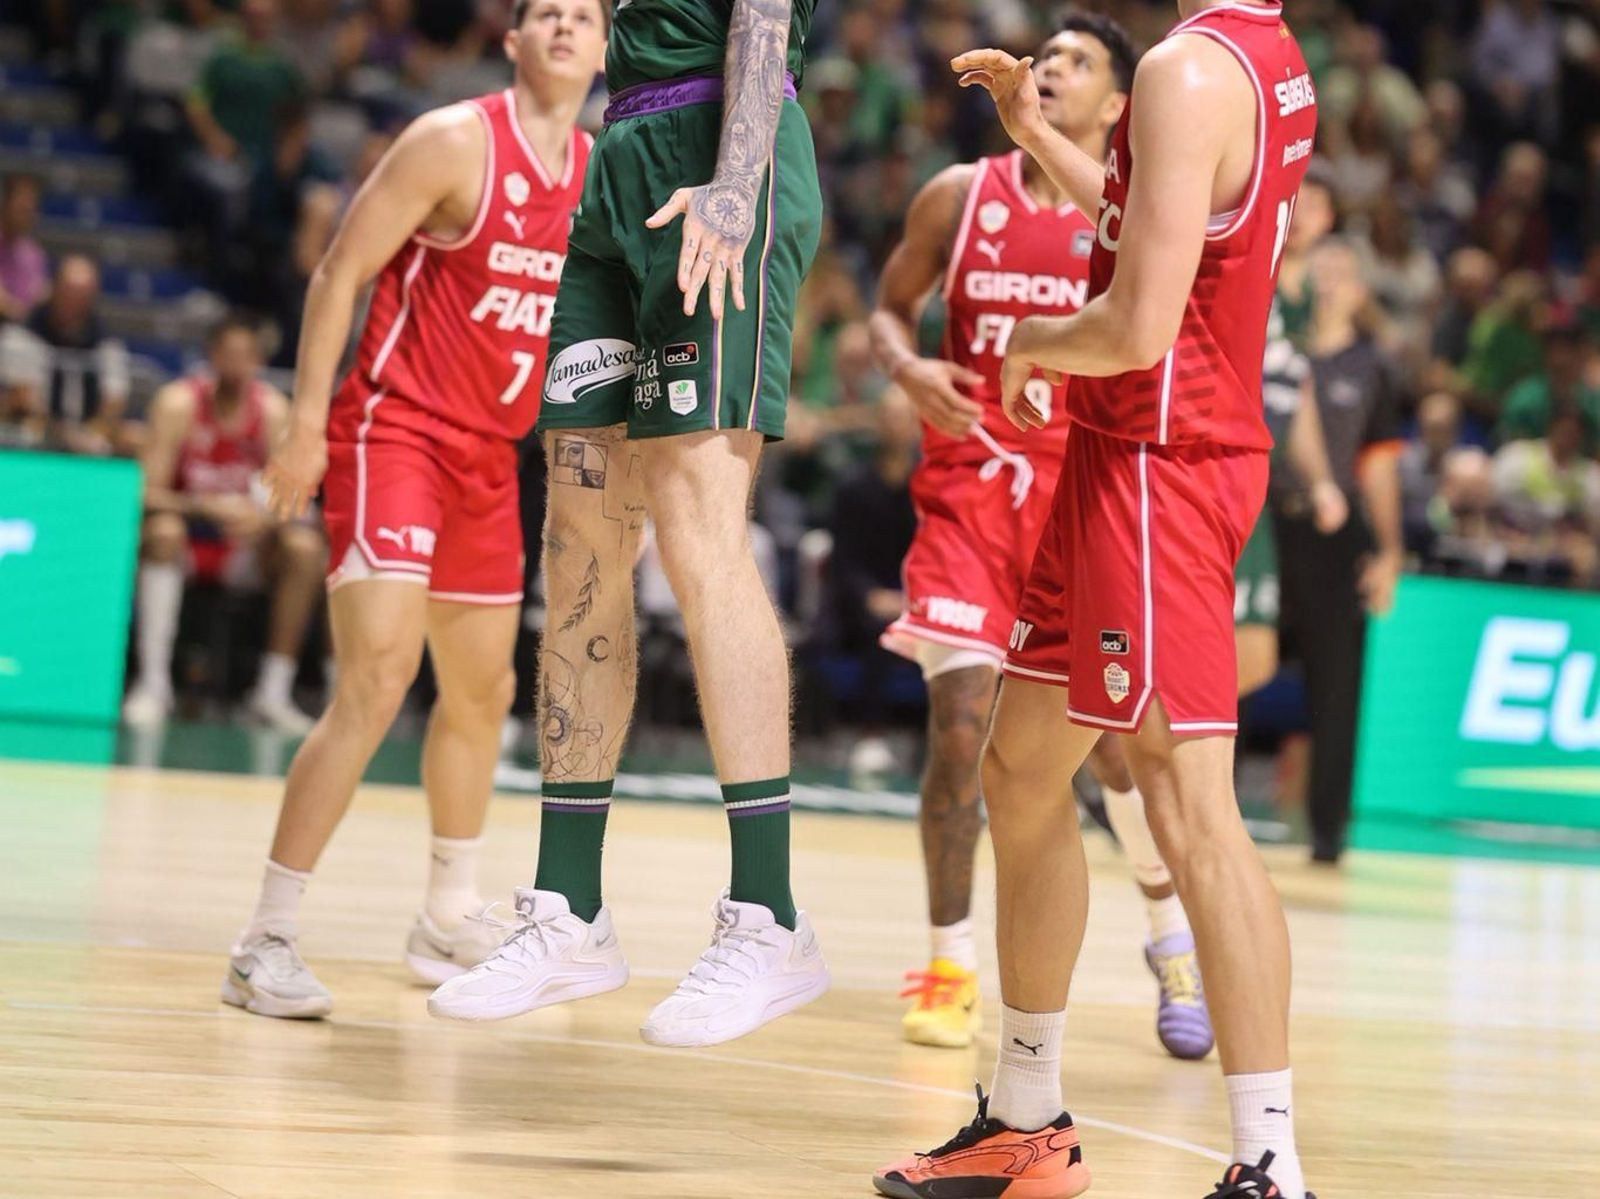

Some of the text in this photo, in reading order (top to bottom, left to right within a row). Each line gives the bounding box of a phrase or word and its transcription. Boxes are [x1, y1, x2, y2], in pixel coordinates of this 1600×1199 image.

[487, 240, 567, 283] GIRO
[666, 351, 691, 363] acb
[500, 350, 536, 405] 7
[1102, 640, 1122, 651] acb
